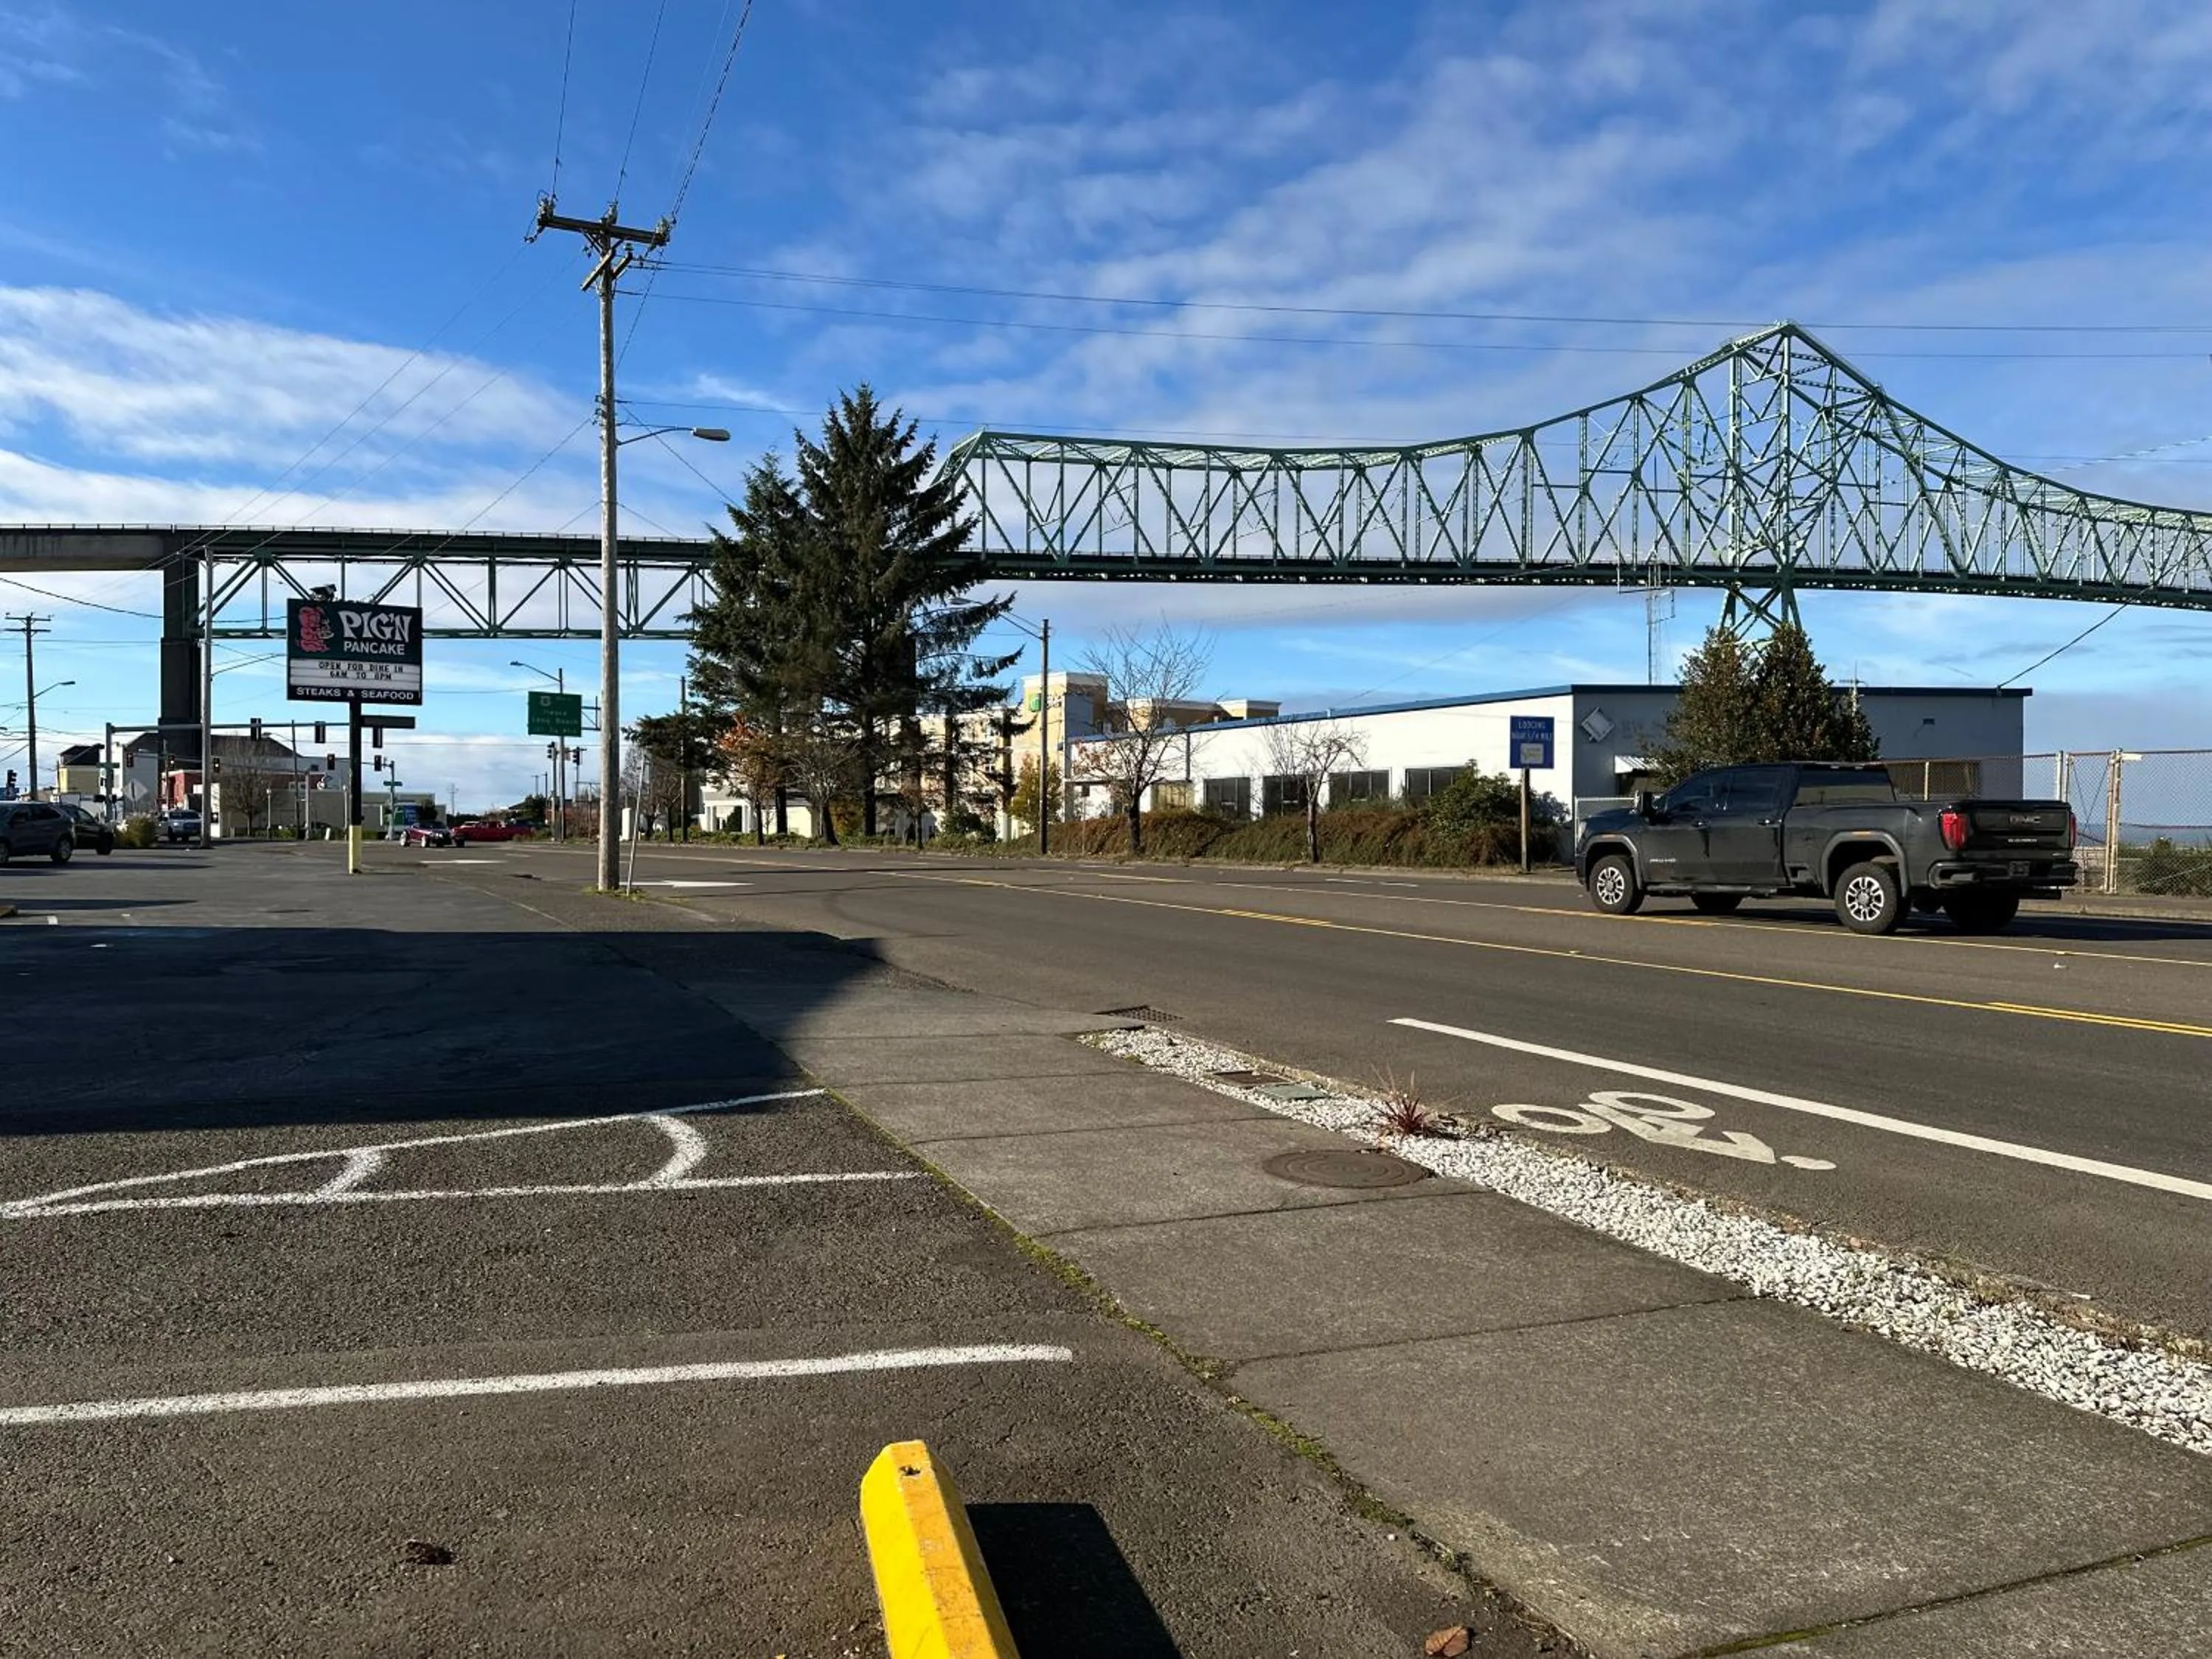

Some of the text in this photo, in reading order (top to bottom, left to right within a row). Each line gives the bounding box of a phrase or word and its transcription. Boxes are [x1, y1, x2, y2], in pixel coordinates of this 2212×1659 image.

[338, 610, 412, 643] PIG'N
[344, 641, 405, 655] PANCAKE
[319, 661, 403, 673] OPEN FOR DINE IN
[356, 672, 366, 680] TO
[296, 686, 414, 700] STEAKS & SEAFOOD
